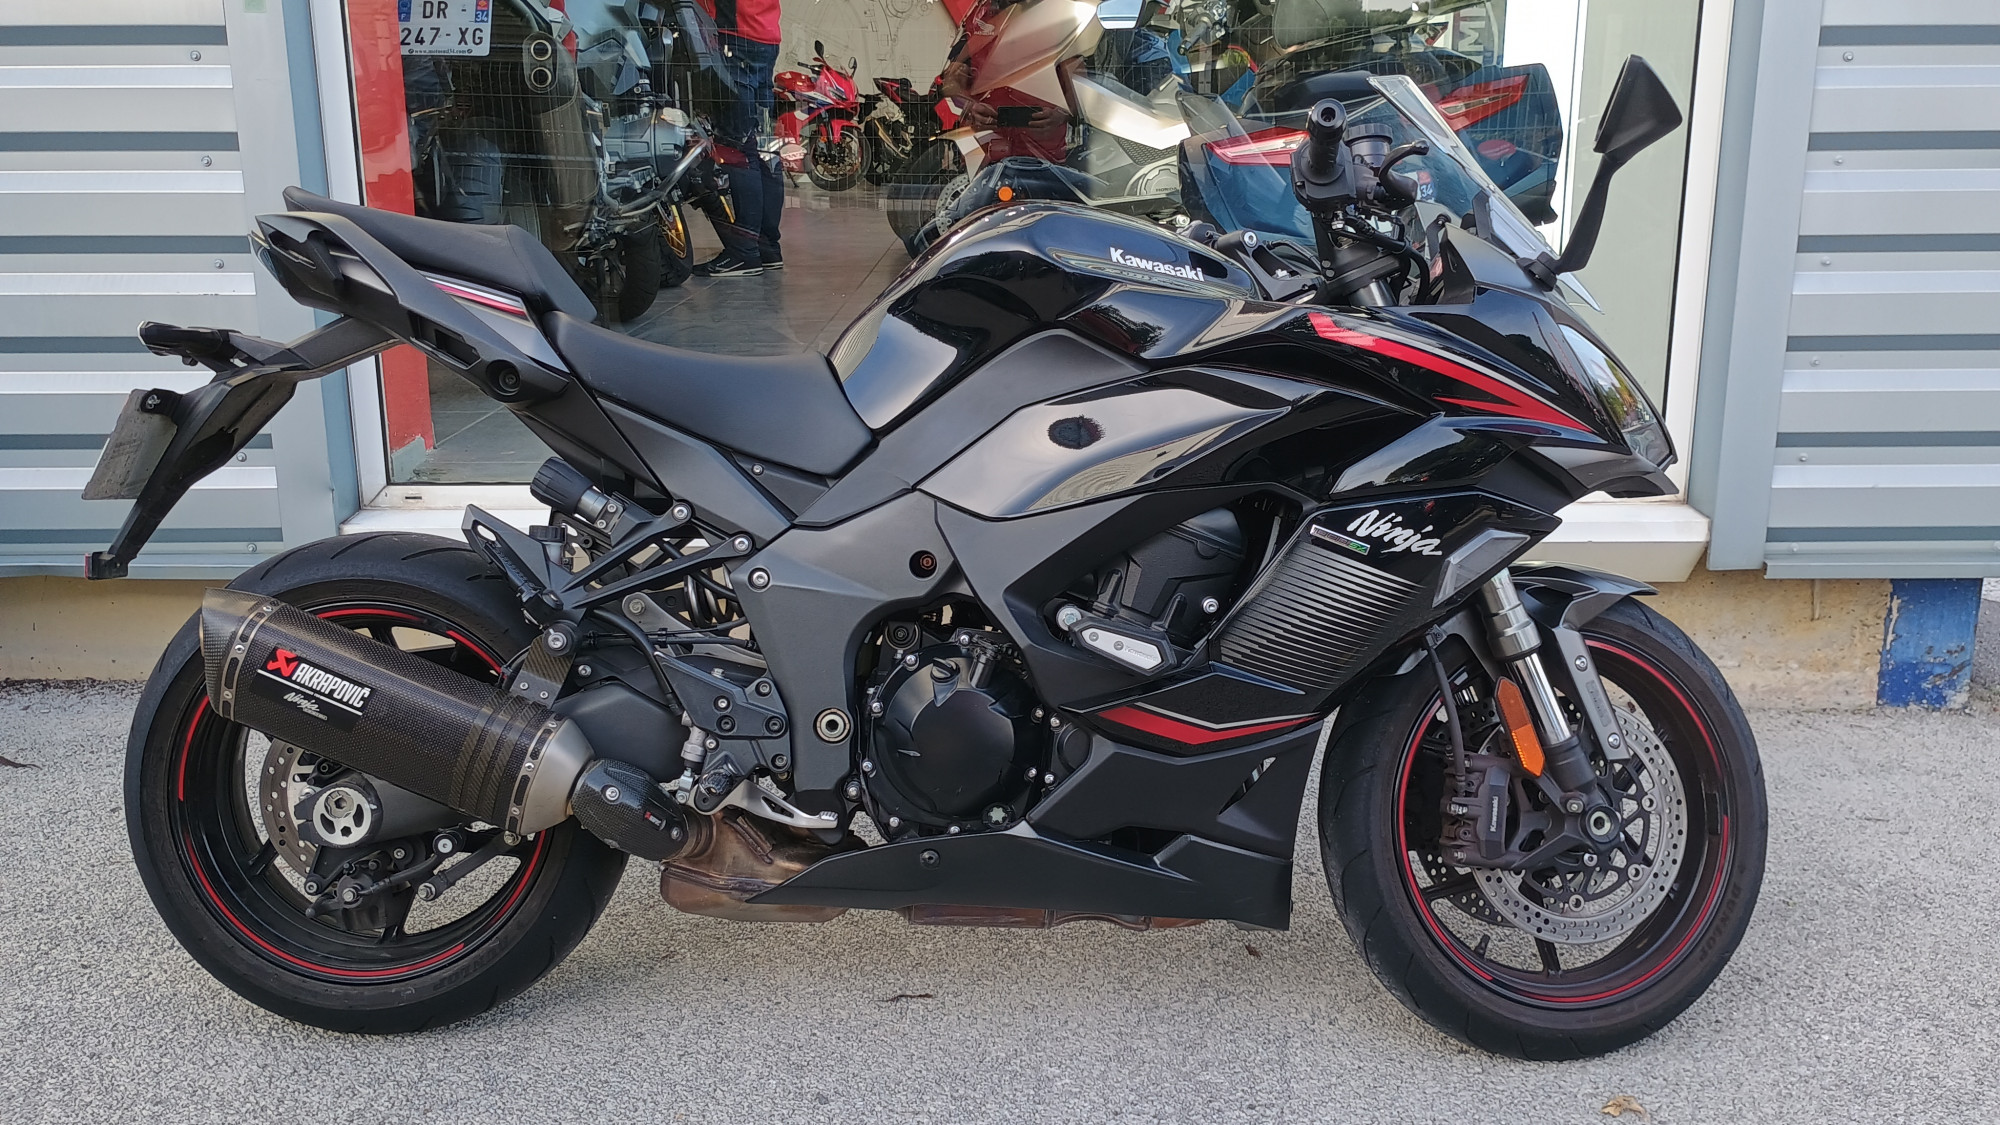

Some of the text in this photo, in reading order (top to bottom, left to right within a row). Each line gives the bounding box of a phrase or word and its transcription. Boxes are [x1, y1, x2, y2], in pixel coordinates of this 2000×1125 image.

[422, 1, 449, 19] DR
[475, 11, 488, 22] 34
[1420, 184, 1433, 198] 34
[1109, 246, 1205, 282] Kawasaki
[1346, 509, 1443, 556] Ninja
[292, 663, 371, 708] AKRAPOVIČ
[283, 692, 320, 712] Ninja
[1699, 881, 1743, 962] DUNLOP
